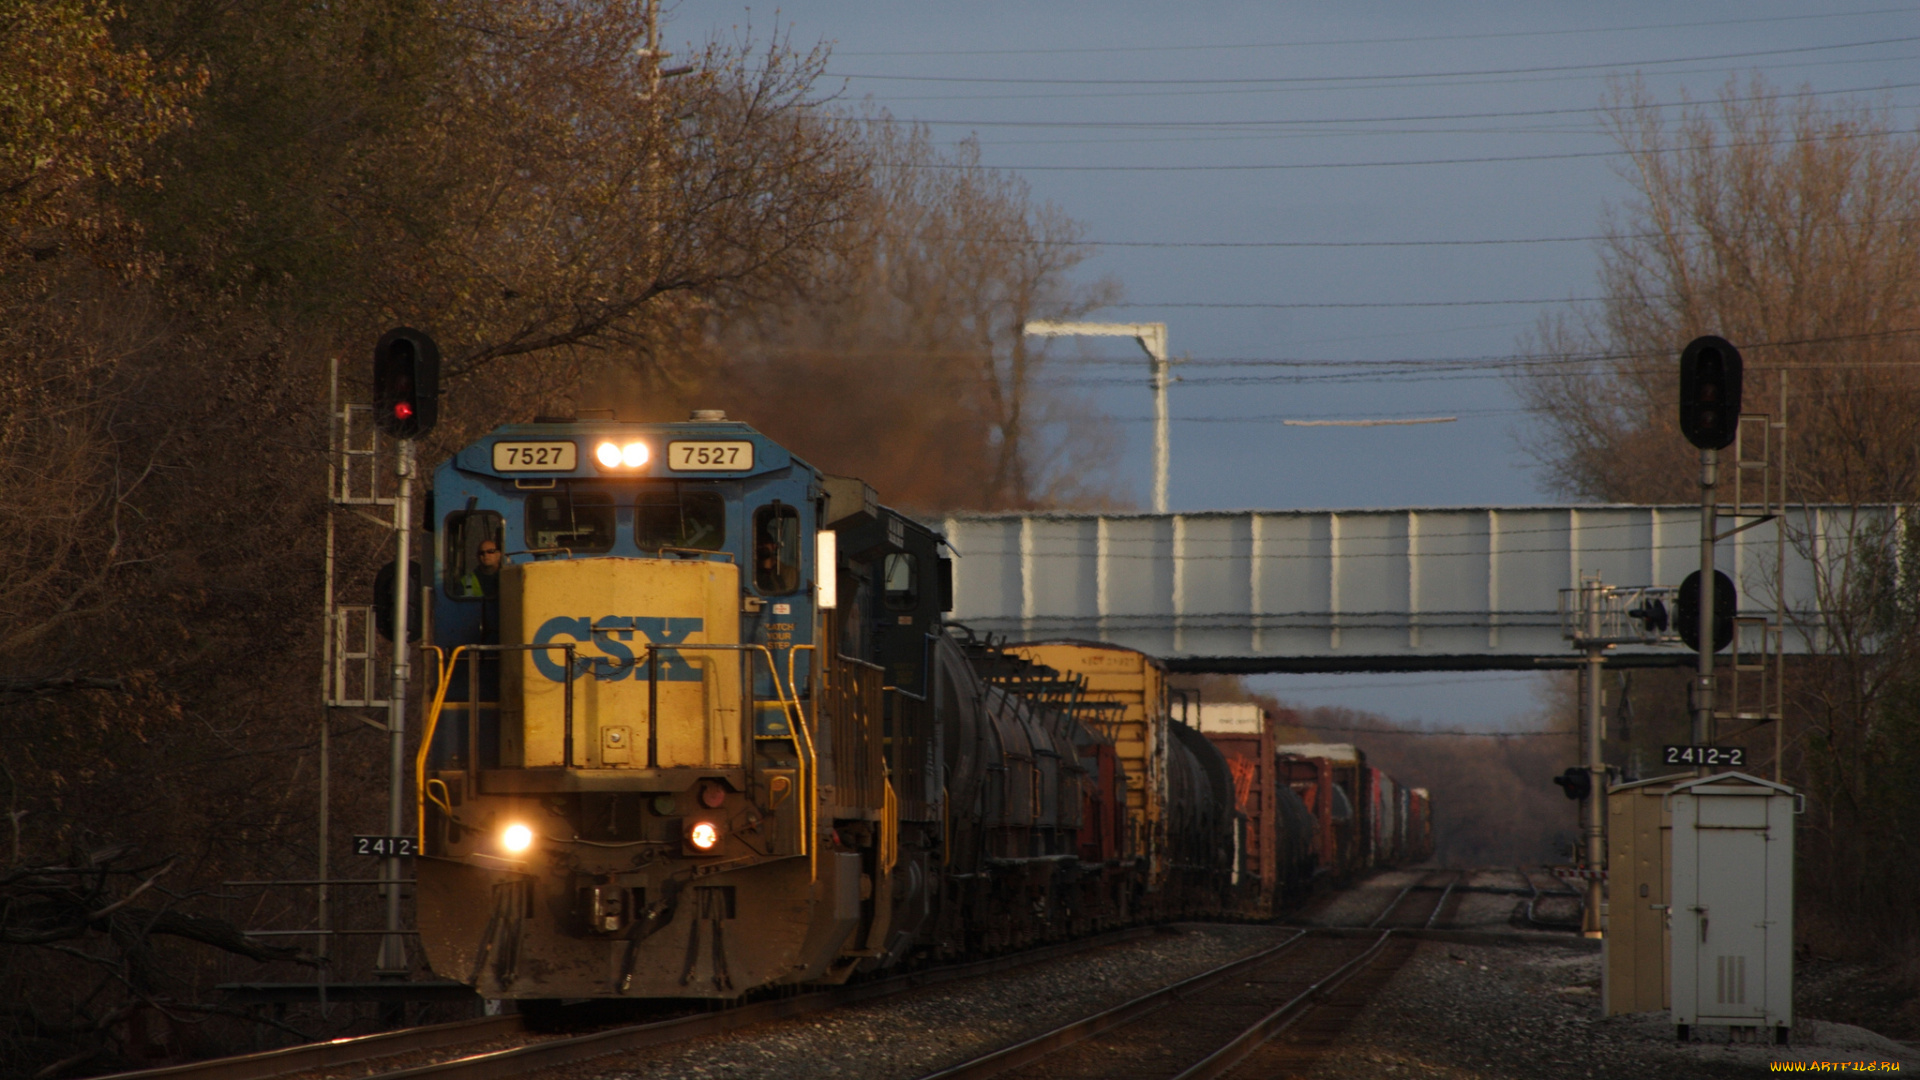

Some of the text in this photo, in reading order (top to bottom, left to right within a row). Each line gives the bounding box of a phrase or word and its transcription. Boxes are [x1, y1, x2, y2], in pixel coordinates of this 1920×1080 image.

[507, 447, 563, 465] 7527
[683, 447, 739, 465] 7527
[766, 632, 792, 640] YOUR
[531, 615, 703, 682] CSX
[767, 641, 790, 650] STEP
[1667, 747, 1742, 765] 2412-2
